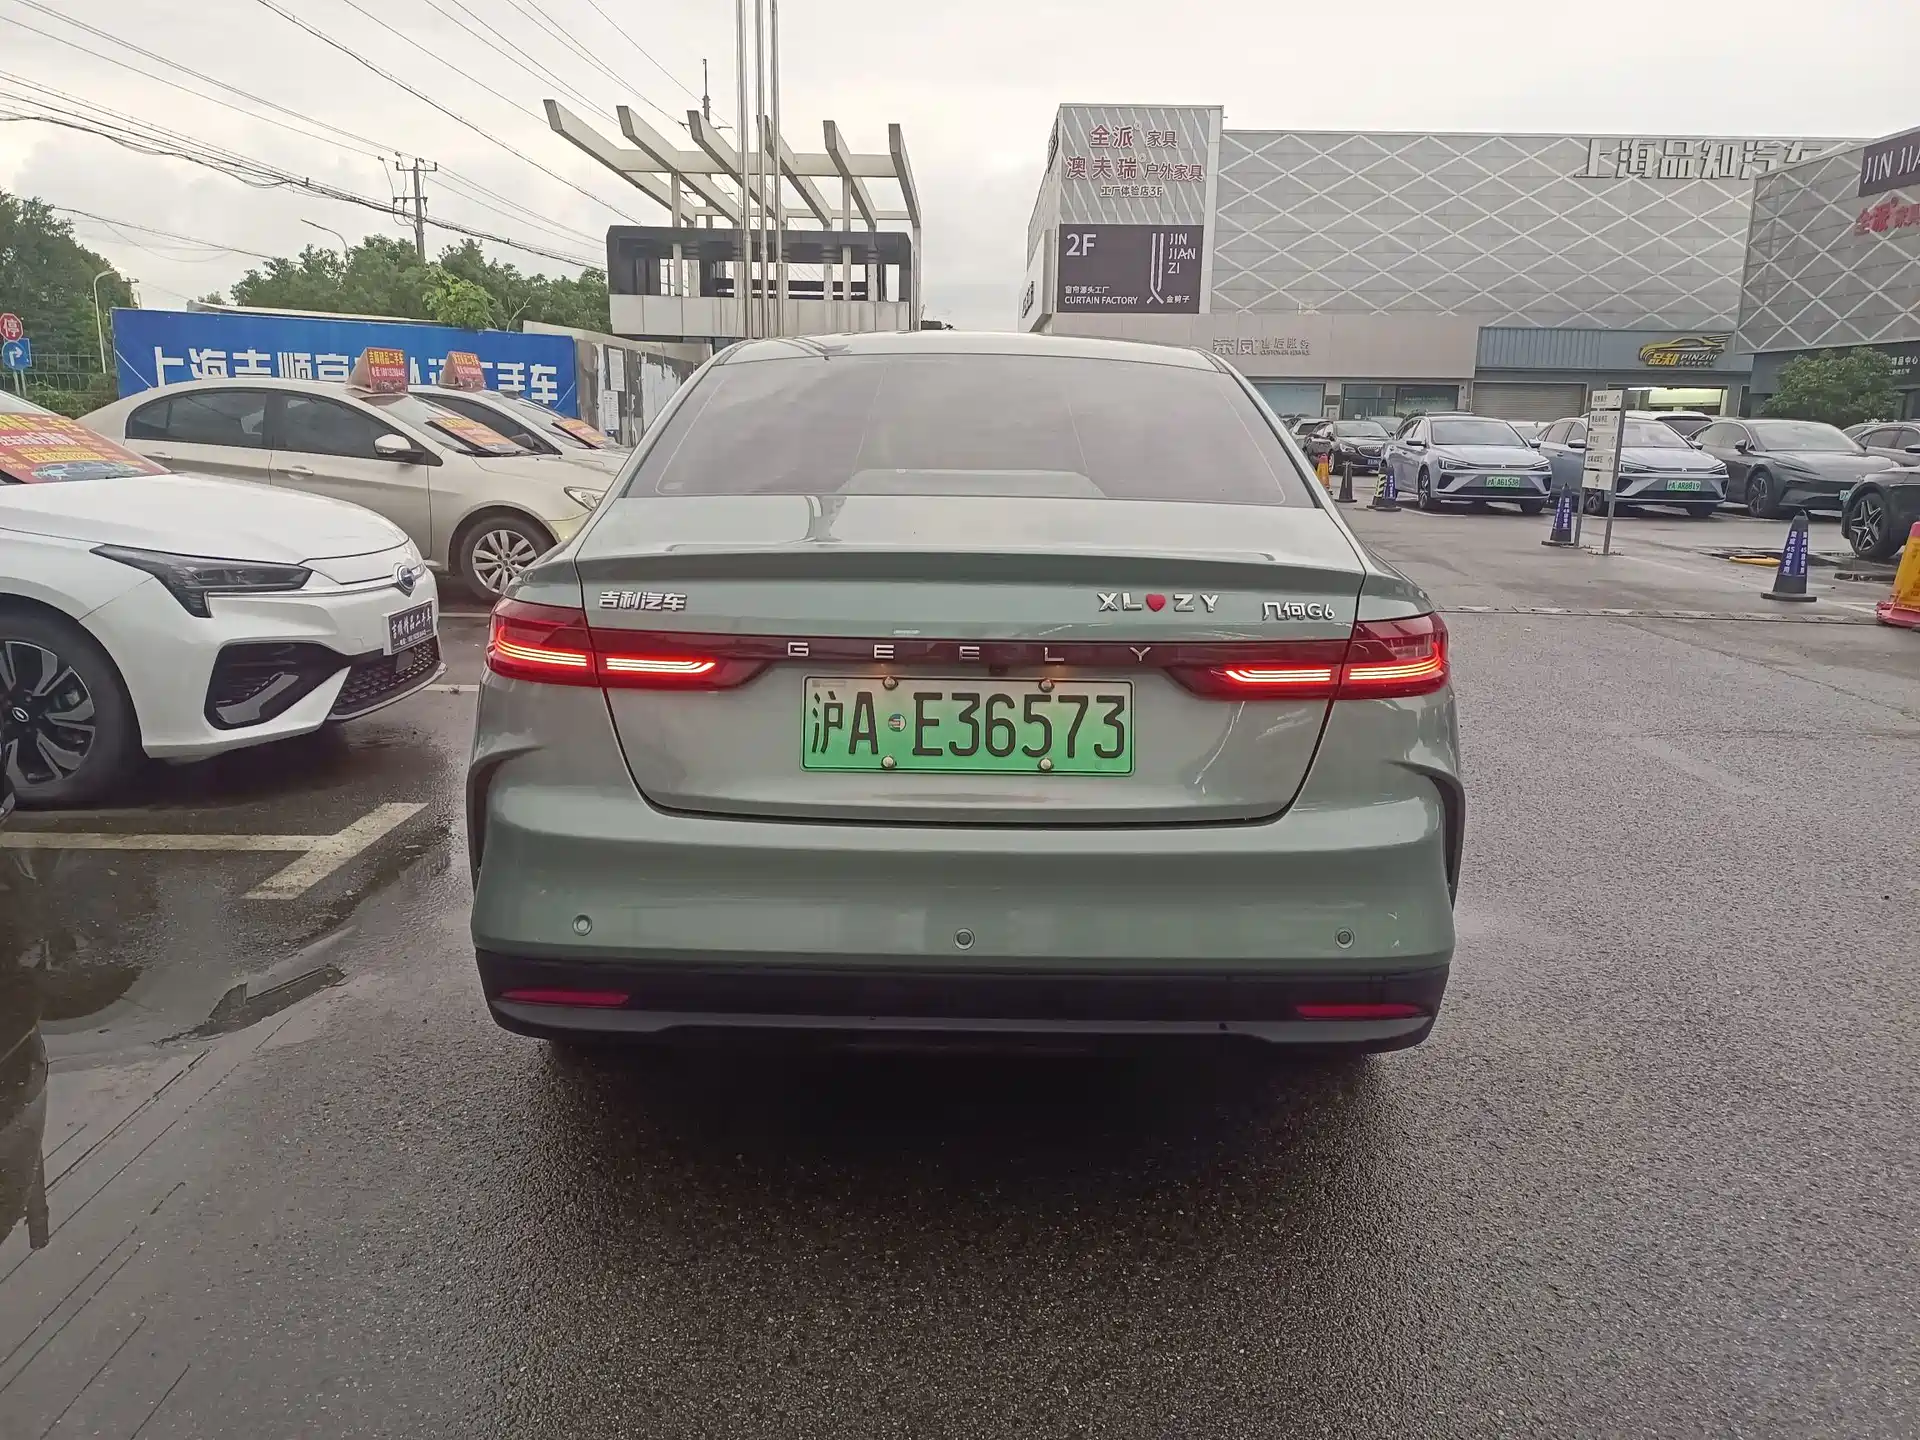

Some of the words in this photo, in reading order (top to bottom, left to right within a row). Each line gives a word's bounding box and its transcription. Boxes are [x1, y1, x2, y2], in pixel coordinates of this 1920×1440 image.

[1090, 124, 1133, 147] 全派
[1147, 130, 1177, 148] 家具
[1066, 156, 1137, 179] 澳夫瑞
[1144, 162, 1204, 181] 户外家具
[1864, 150, 1894, 184] JIN
[1101, 186, 1163, 197] 工厂体验店3F
[1066, 233, 1097, 256] 2F
[1169, 233, 1188, 245] JIN
[1168, 248, 1196, 260] JIAN
[1167, 262, 1180, 274] ZI
[1064, 285, 1110, 294] 窗帘源头工厂
[1166, 295, 1190, 304] 金剪子
[1064, 296, 1100, 304] CURTAIN
[1101, 296, 1138, 305] FACTORY
[3, 318, 20, 337] 停
[599, 590, 687, 611] 吉利汽车
[1097, 592, 1142, 611] XL
[1173, 593, 1220, 612] ZY
[1262, 601, 1336, 621] 几何G6
[787, 641, 1151, 662] GEELY
[811, 691, 879, 755] 沪A
[912, 692, 1126, 759] E36573
